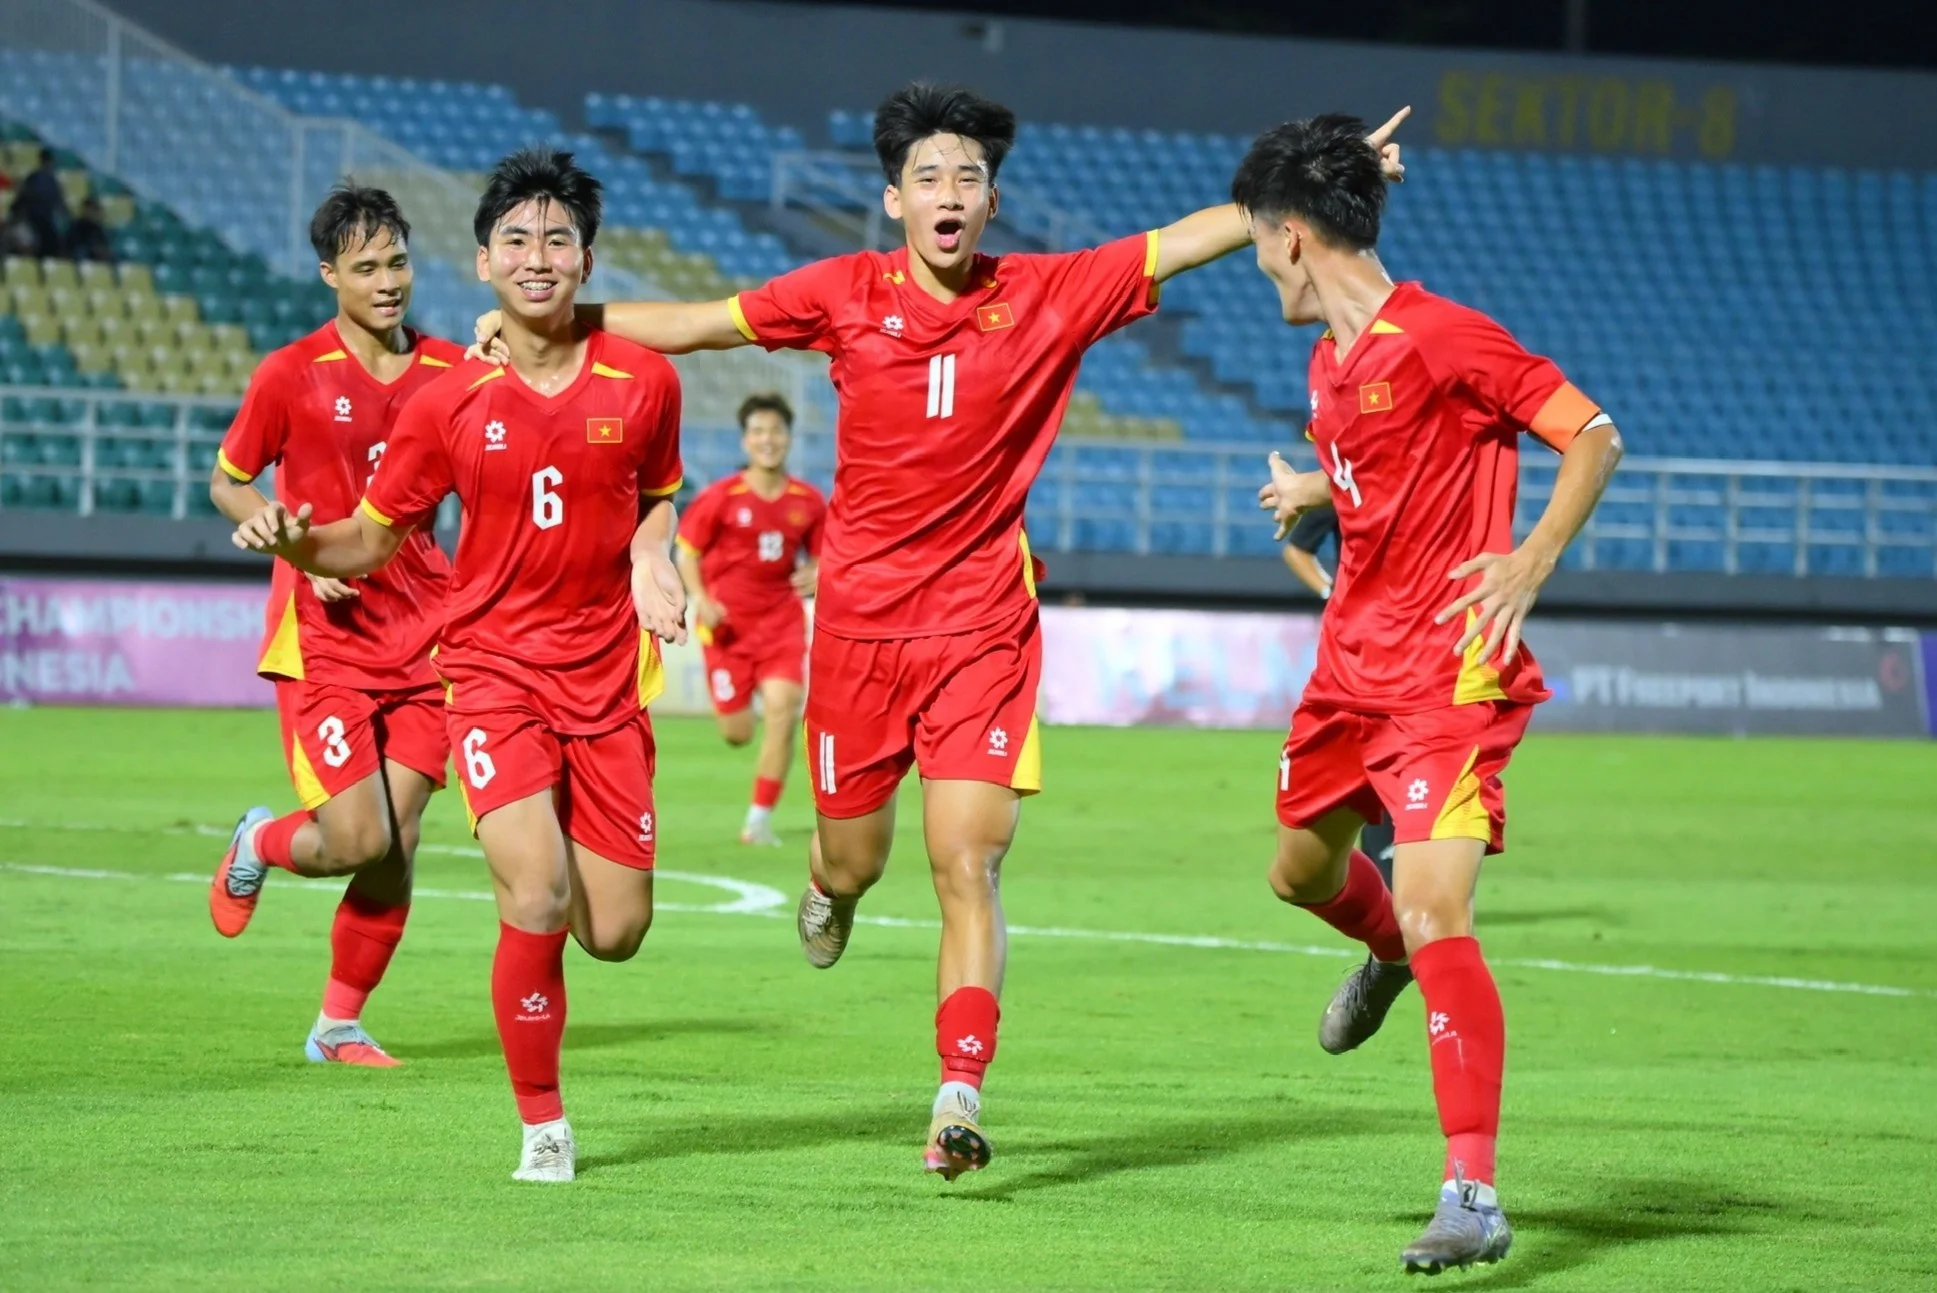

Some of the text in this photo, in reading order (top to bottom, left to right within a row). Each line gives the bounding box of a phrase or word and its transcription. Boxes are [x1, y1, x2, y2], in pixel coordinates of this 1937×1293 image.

[926, 353, 956, 419] 11
[532, 465, 563, 531] 6
[1330, 440, 1363, 509] 4
[0, 594, 266, 640] HAMPIONSH
[0, 652, 134, 693] NESIA
[317, 715, 352, 768] 3
[462, 727, 497, 790] 6
[819, 731, 837, 795] 11
